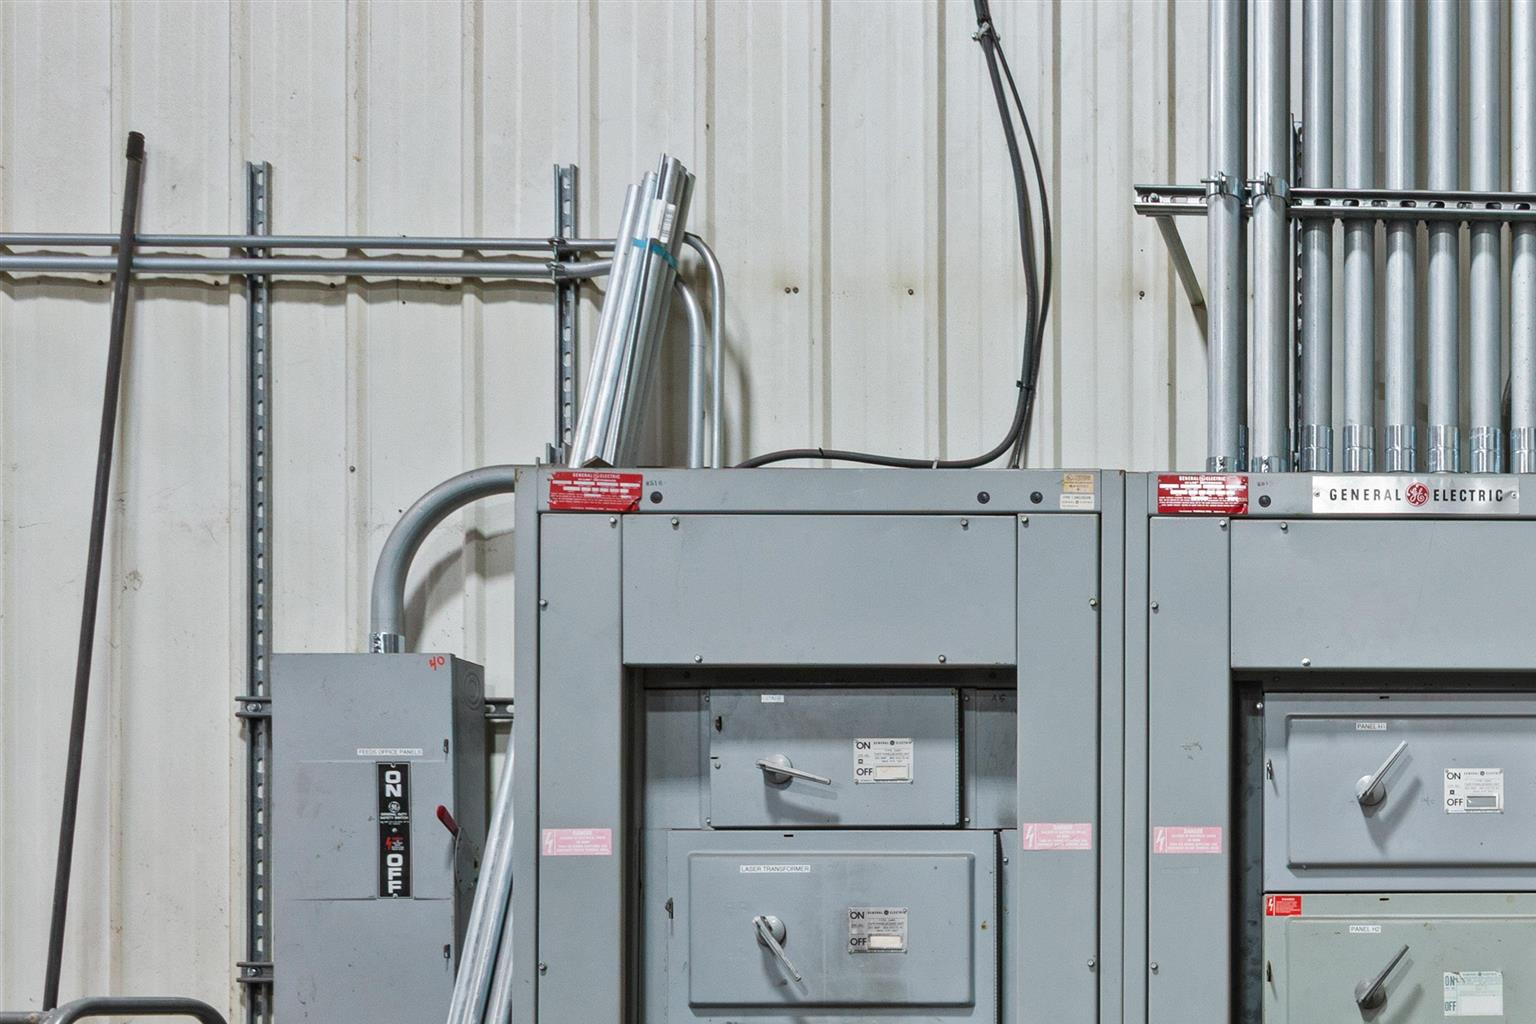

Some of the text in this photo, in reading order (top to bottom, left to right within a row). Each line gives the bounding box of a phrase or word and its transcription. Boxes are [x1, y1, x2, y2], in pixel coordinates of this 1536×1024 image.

[1329, 488, 1402, 501] GENERAL
[1433, 488, 1504, 502] ELECTRIC
[856, 741, 871, 750] ON
[856, 767, 873, 776] OFF
[1446, 772, 1461, 780] ON
[385, 770, 402, 797] ON
[1446, 798, 1463, 806] OFF
[387, 853, 403, 894] OFF
[850, 911, 865, 920] ON
[850, 937, 867, 946] OFF
[1444, 975, 1455, 986] ON
[1444, 1001, 1457, 1012] OFF
